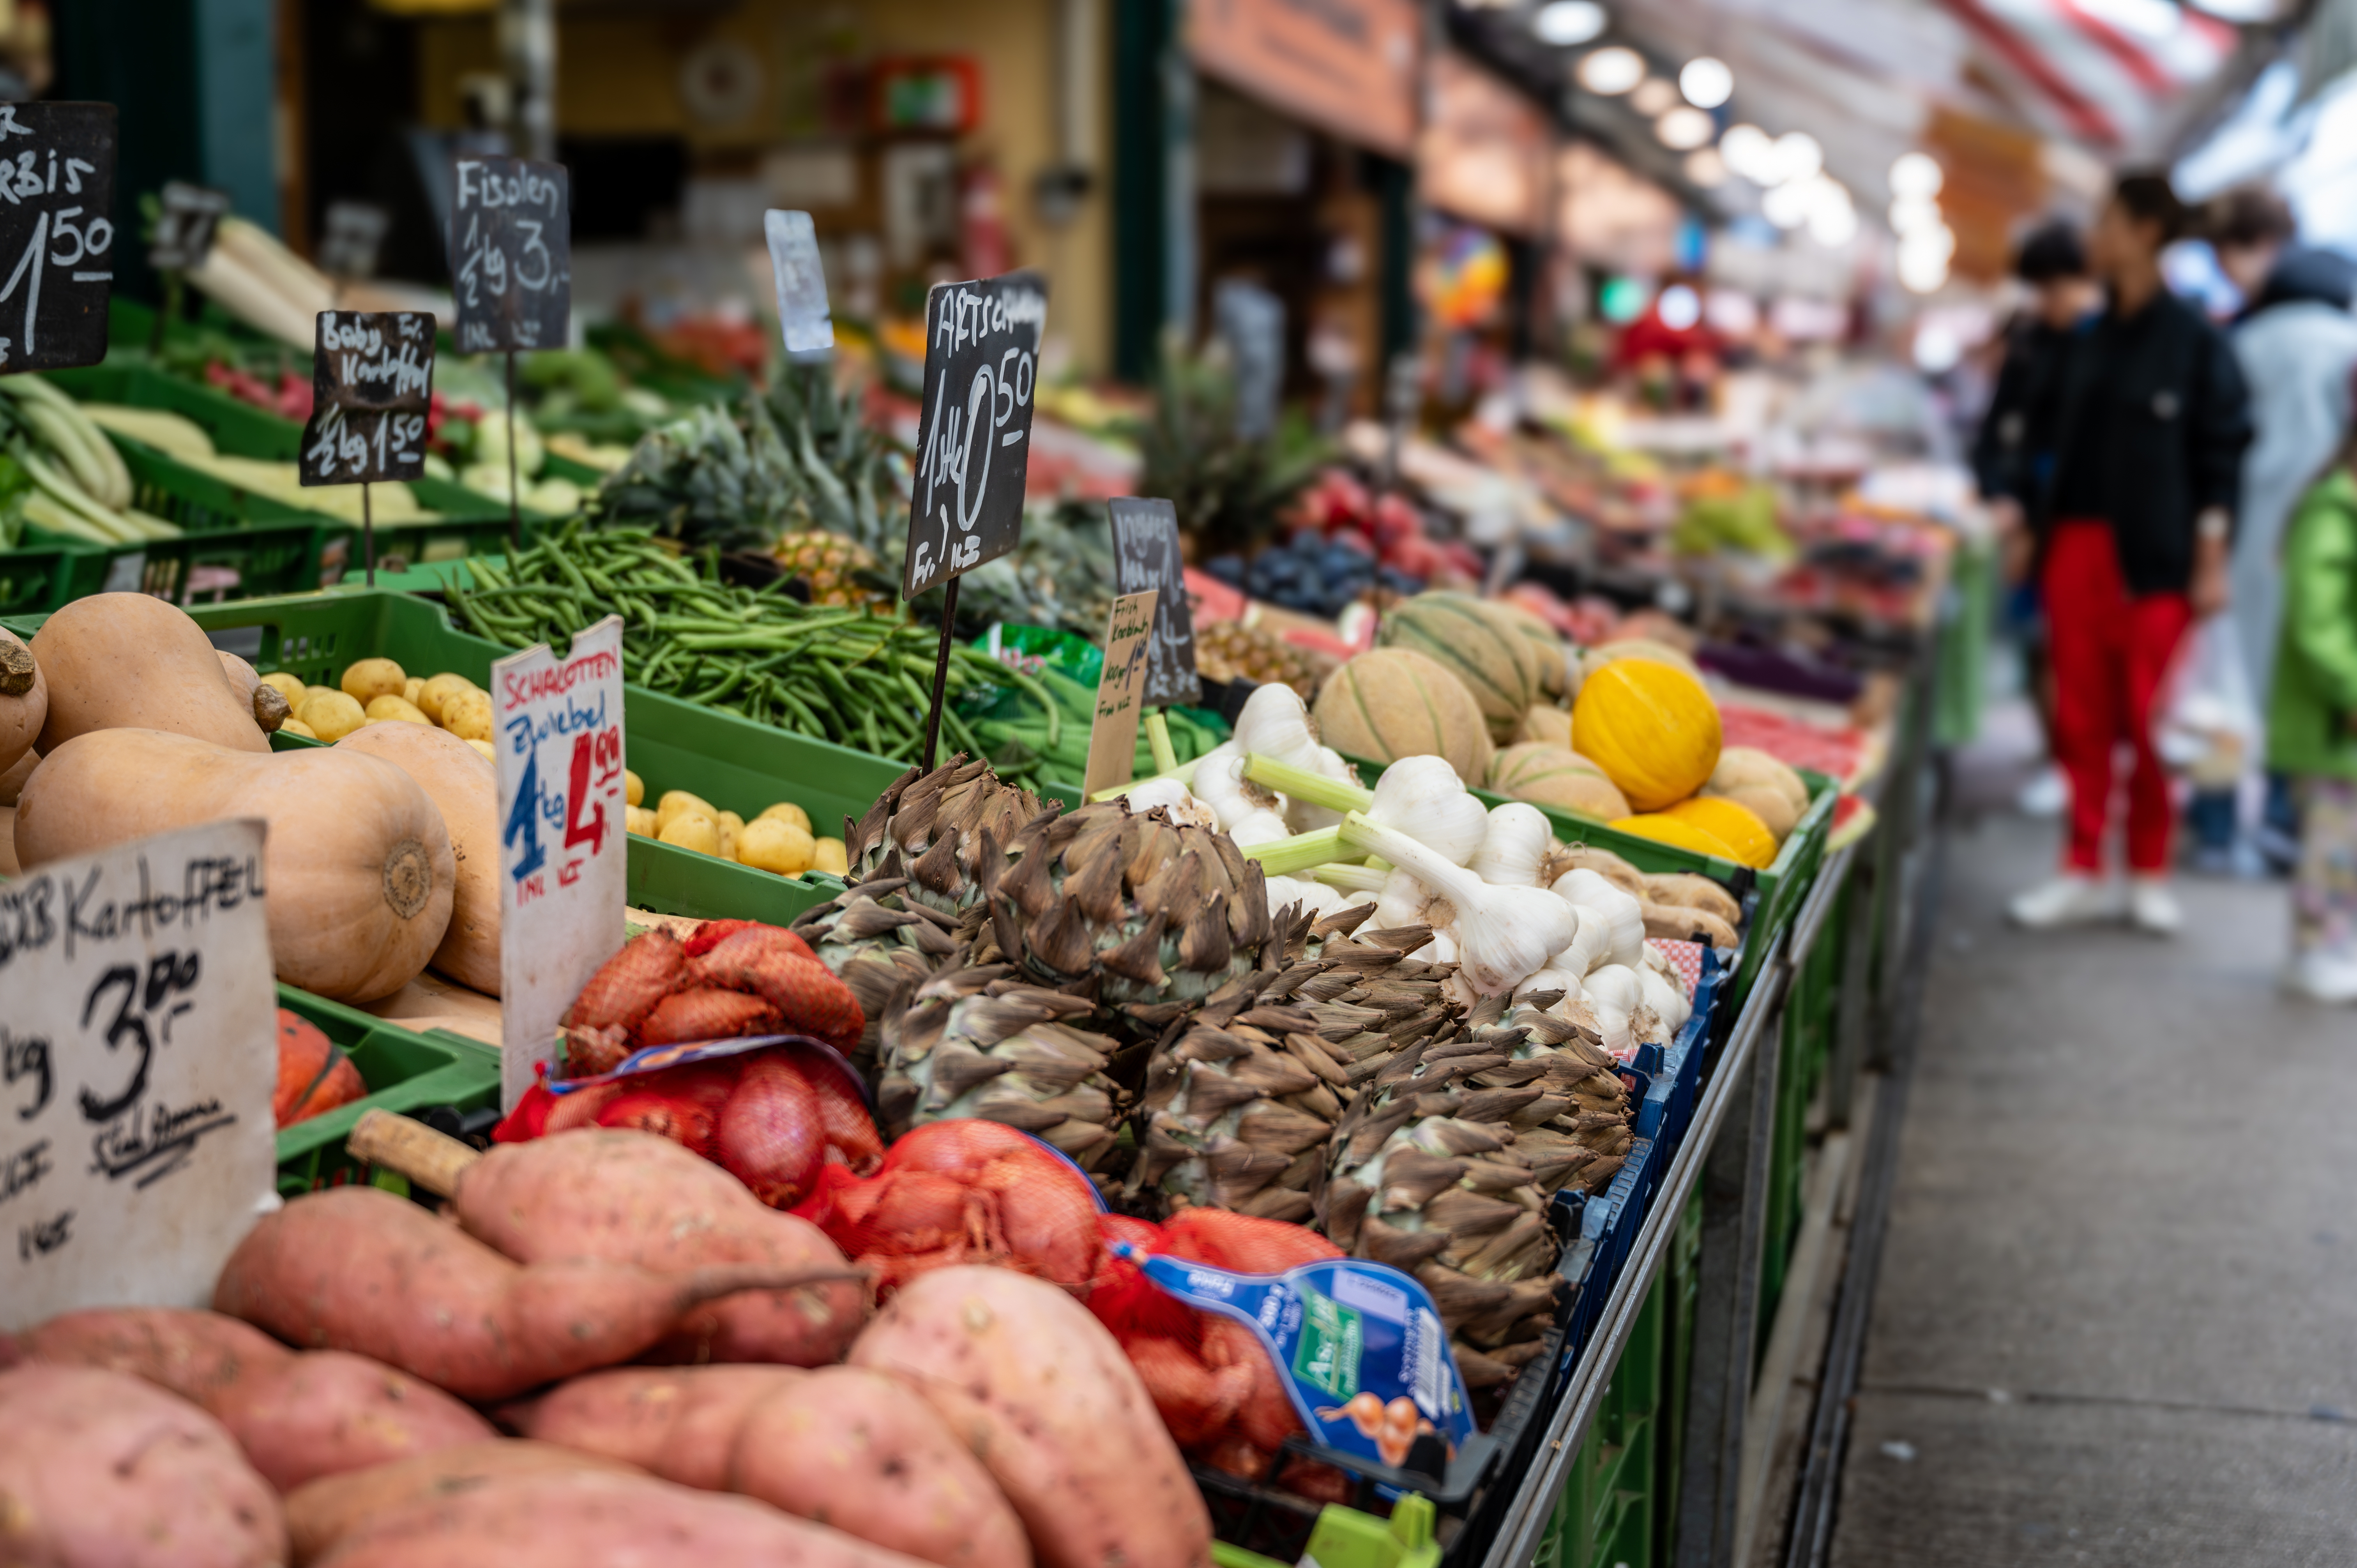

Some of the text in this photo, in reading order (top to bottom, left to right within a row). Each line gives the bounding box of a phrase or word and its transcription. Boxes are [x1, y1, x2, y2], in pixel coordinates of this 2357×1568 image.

[457, 161, 559, 219] Fisolen
[323, 312, 382, 357] Baby
[504, 644, 618, 712] SCHALOTTEN
[505, 689, 607, 755] Zwiebel
[505, 751, 547, 883] 1
[541, 778, 565, 830] kg
